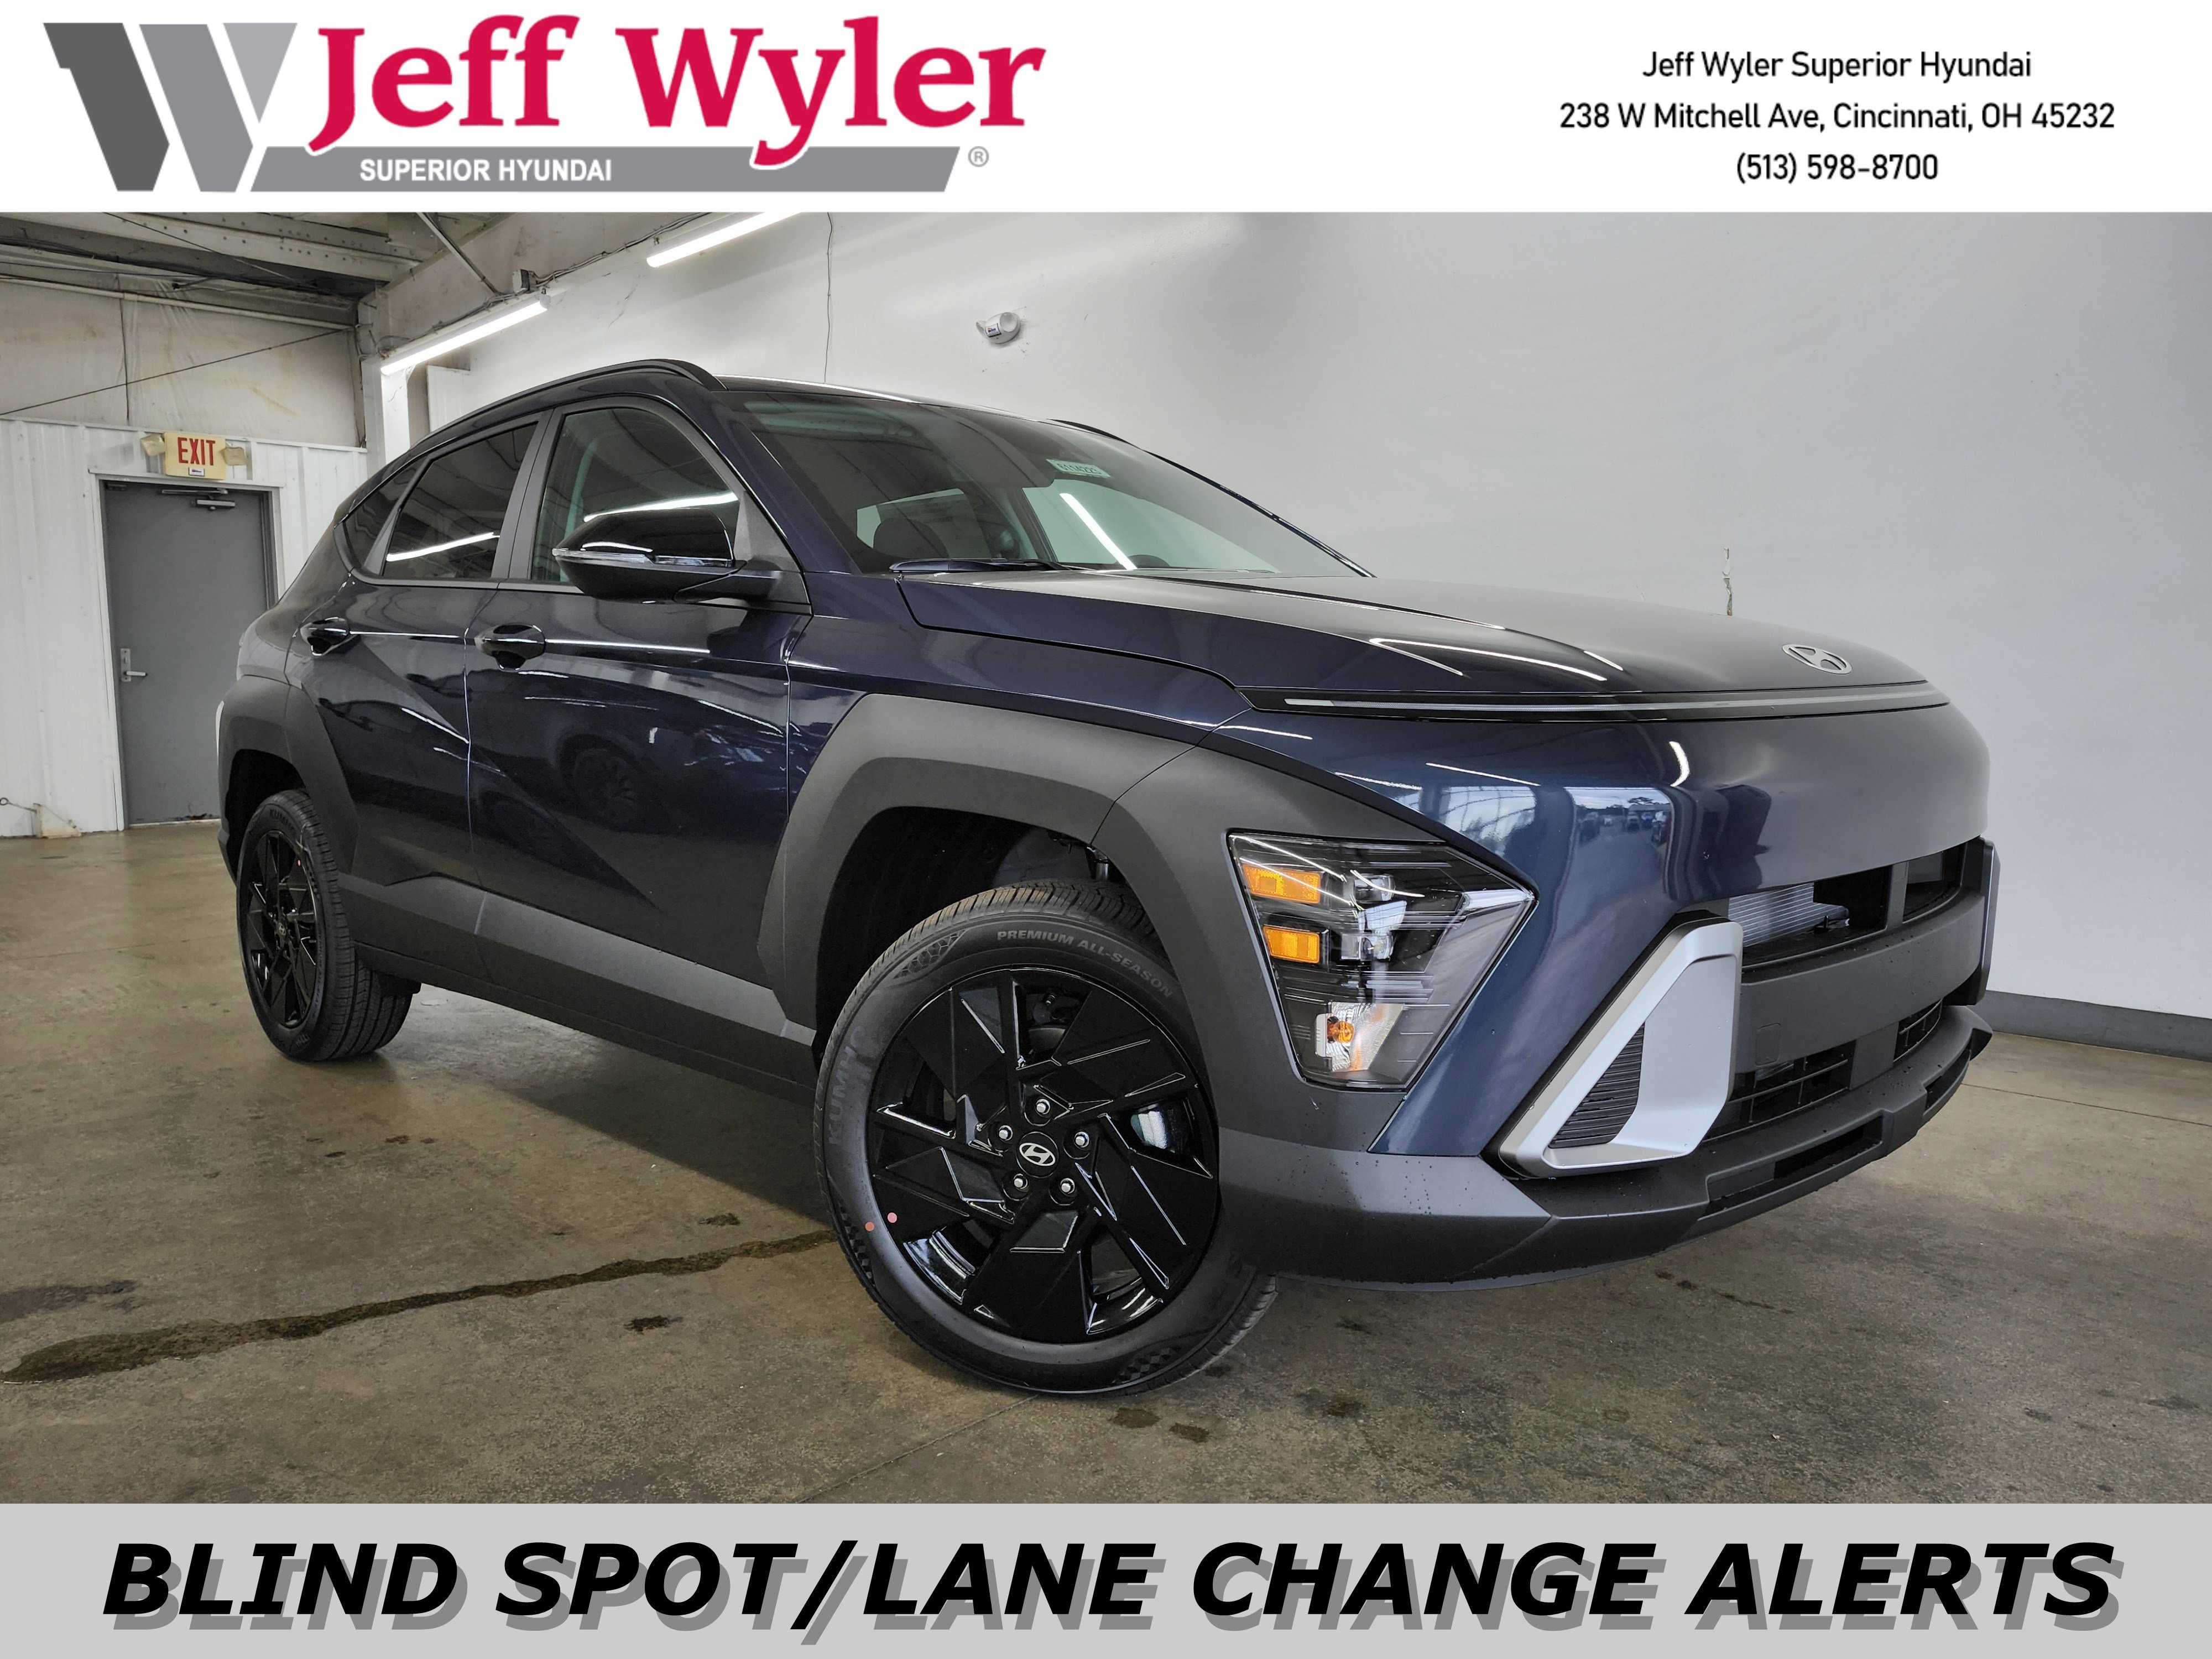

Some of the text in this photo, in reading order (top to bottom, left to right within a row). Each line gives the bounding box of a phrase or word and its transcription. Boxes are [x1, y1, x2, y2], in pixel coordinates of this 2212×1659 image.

[178, 437, 216, 466] EXIT
[997, 929, 1173, 997] PREMIUM ALL-SEASON
